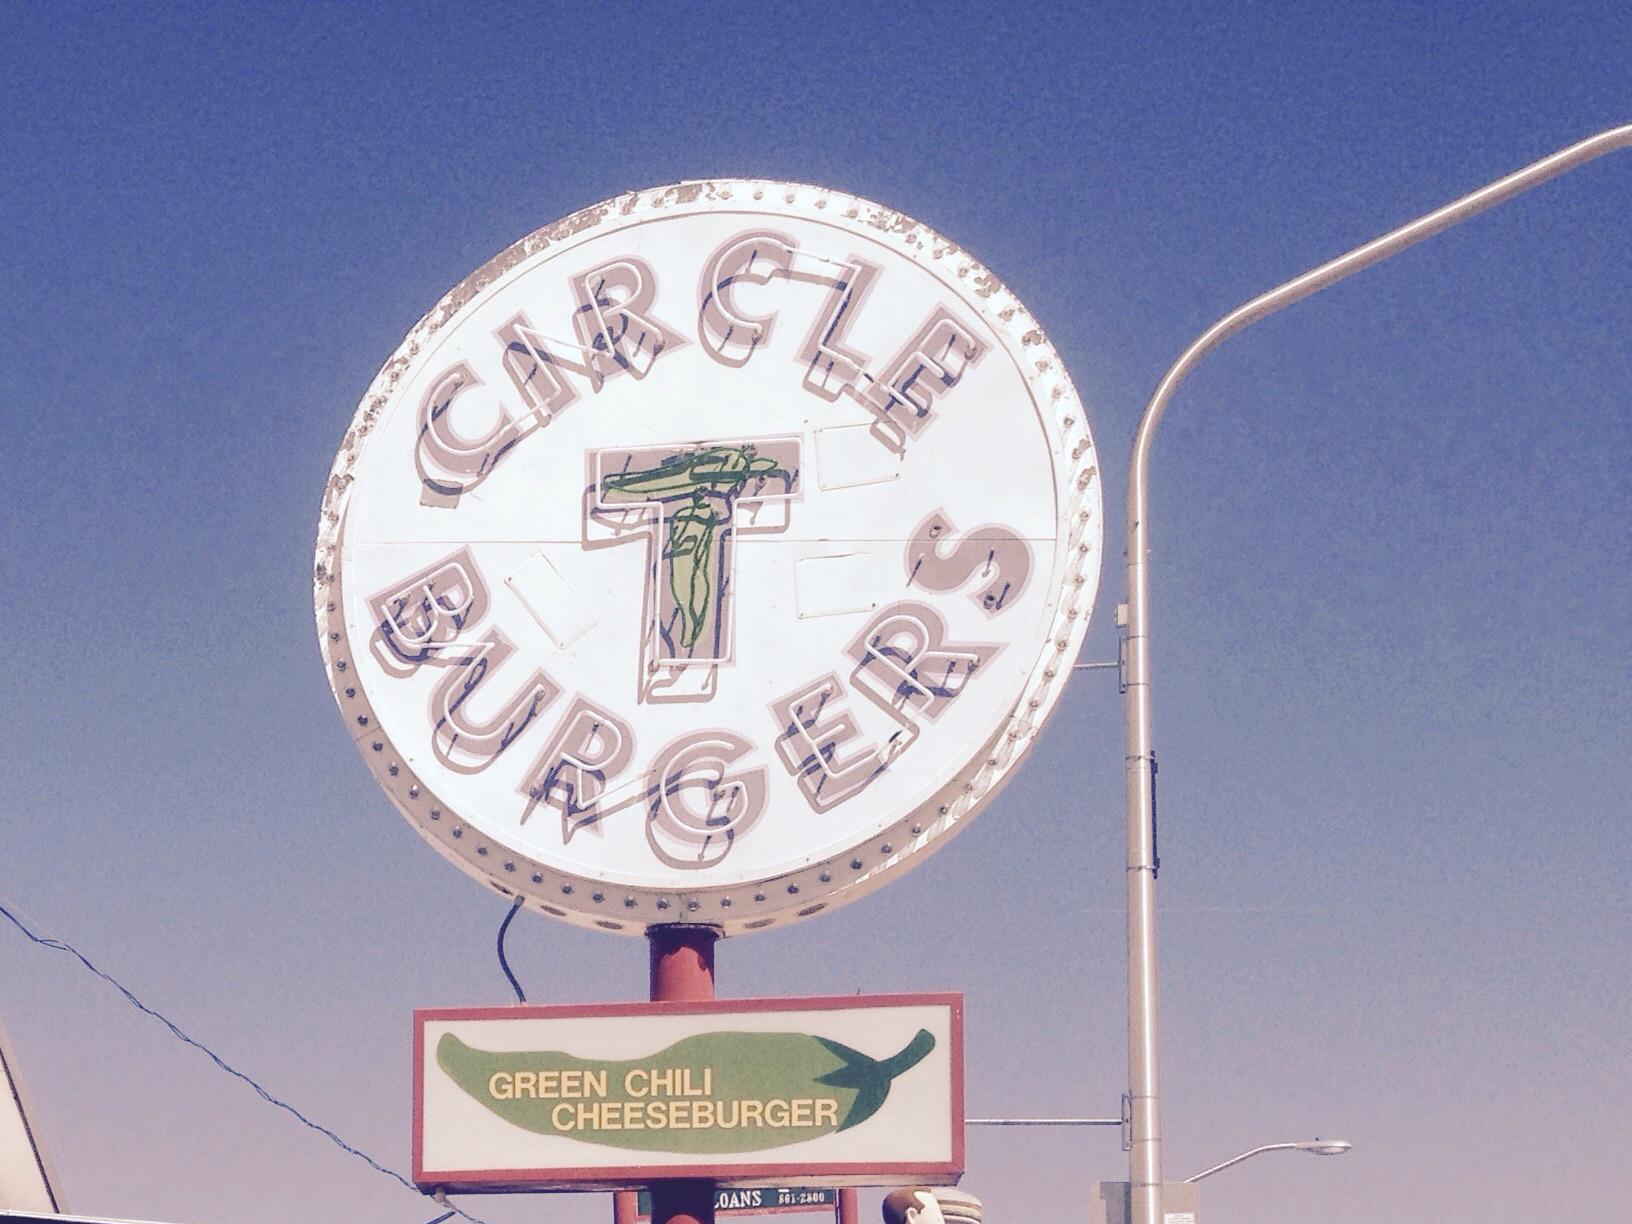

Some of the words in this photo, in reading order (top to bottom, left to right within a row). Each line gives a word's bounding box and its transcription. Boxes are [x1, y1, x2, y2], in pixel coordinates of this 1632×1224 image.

[584, 433, 804, 670] T
[366, 507, 1035, 846] BURGERS
[488, 1071, 607, 1099] GREEN
[624, 1068, 712, 1098] CHILI
[551, 1099, 839, 1131] CHEESEBURGER
[715, 1190, 762, 1209] OANS
